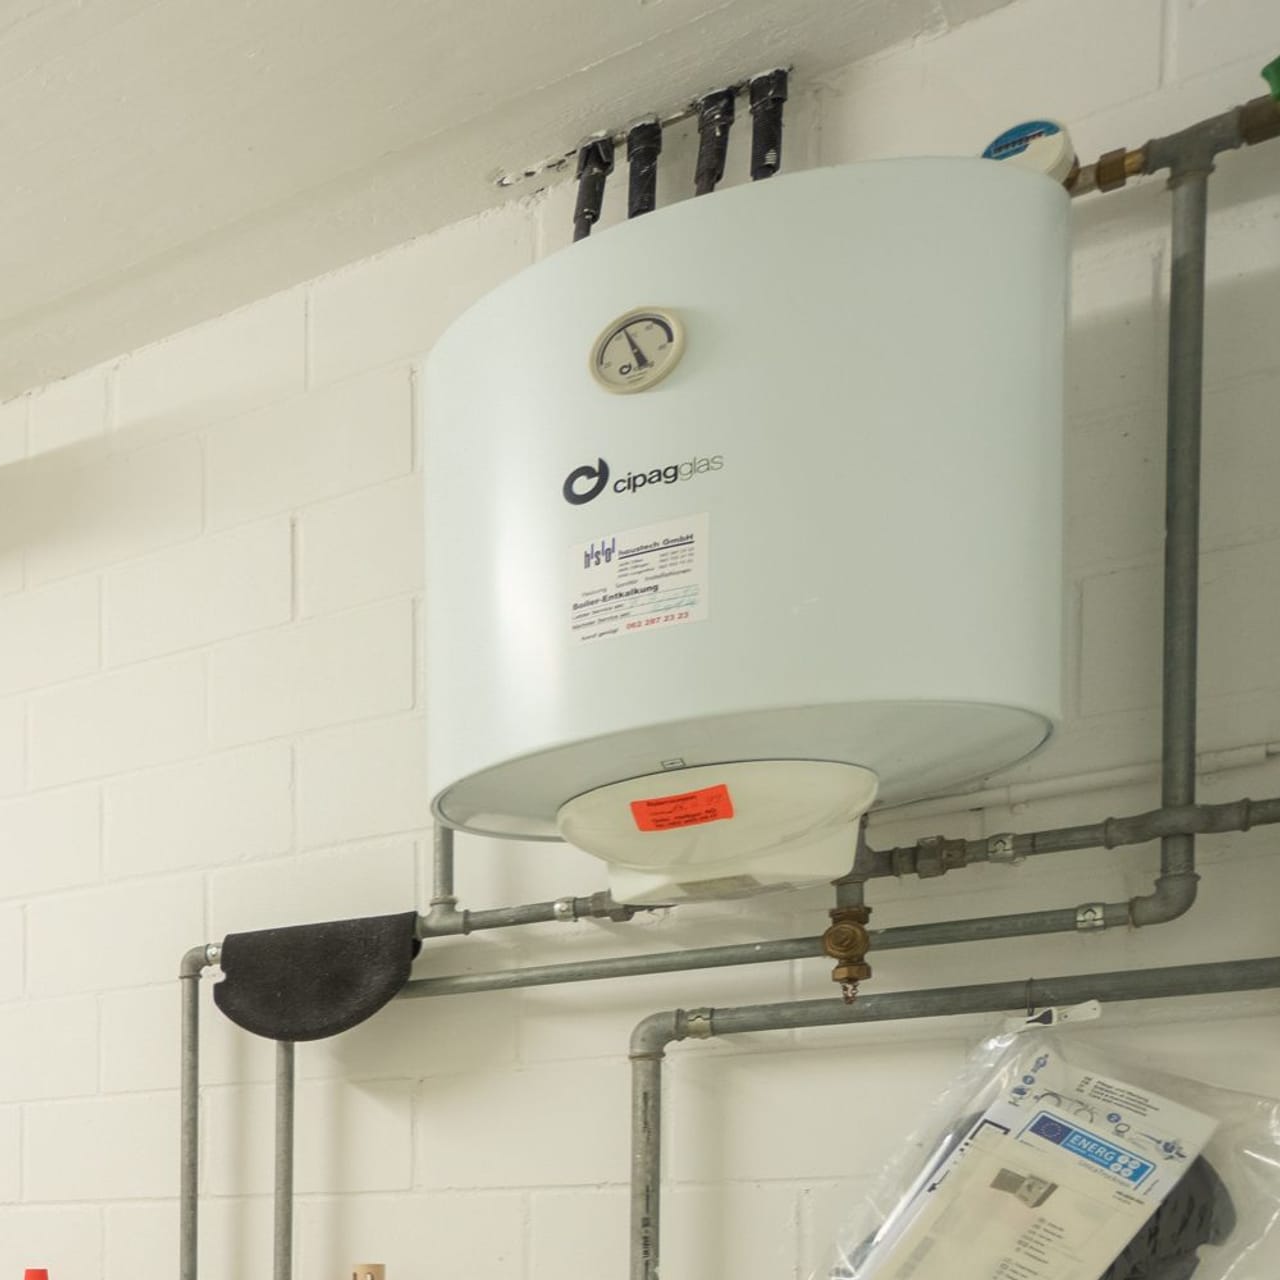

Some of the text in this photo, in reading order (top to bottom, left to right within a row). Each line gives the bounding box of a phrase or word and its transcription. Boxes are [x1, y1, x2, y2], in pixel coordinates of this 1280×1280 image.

[662, 533, 694, 546] GmbH
[572, 584, 659, 611] Boiler-Entkalkung
[1069, 1133, 1117, 1162] ENERG
